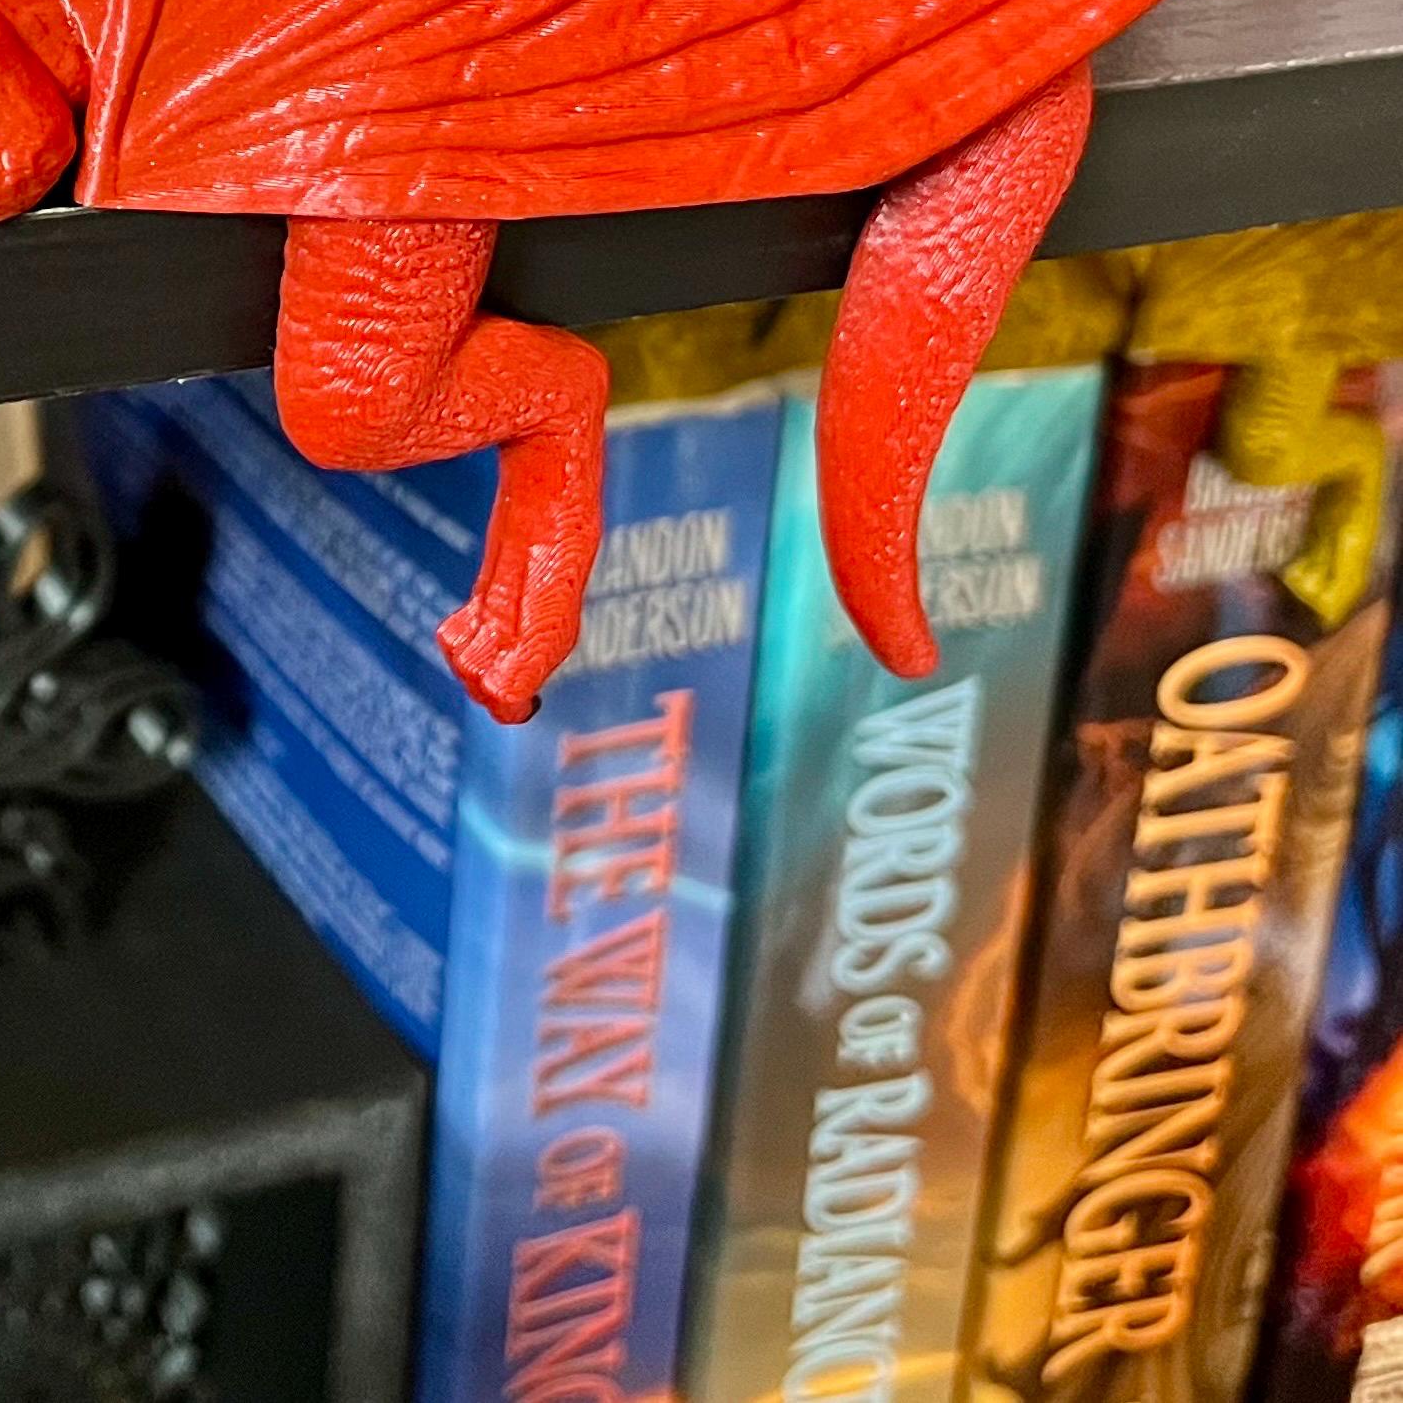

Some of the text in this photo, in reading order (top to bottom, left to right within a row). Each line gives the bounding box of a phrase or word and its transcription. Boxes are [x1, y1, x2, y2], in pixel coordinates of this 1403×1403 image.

[581, 507, 730, 595] ANDON
[545, 687, 695, 925] THE
[829, 674, 980, 996] WORDS
[531, 906, 670, 1120] WAY
[1041, 634, 1313, 1384] OATHBRINGER
